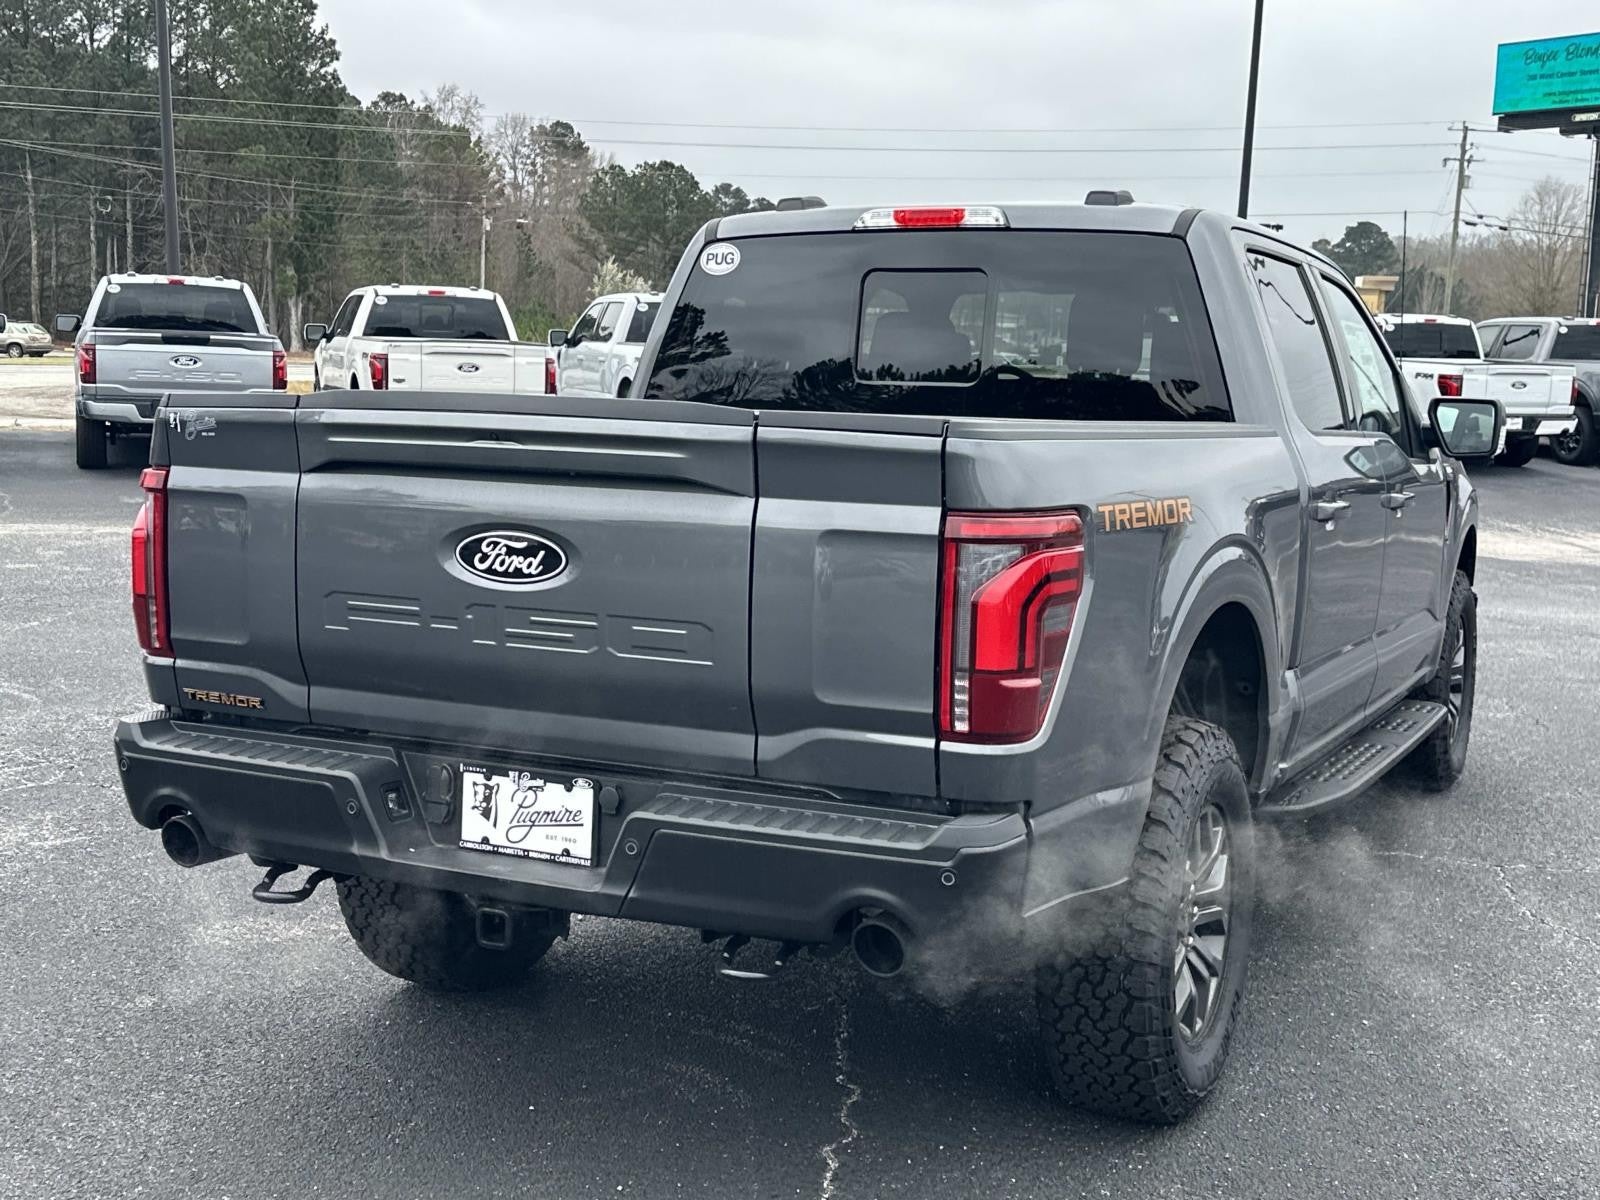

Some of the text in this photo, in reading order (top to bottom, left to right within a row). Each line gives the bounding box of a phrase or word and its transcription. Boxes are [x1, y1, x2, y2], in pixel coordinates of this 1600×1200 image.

[706, 252, 735, 266] PUG
[1097, 497, 1193, 532] TREMOR
[472, 535, 546, 576] Ford
[323, 590, 714, 665] F-150
[182, 687, 264, 709] TREMOR
[505, 788, 585, 844] Pugmire
